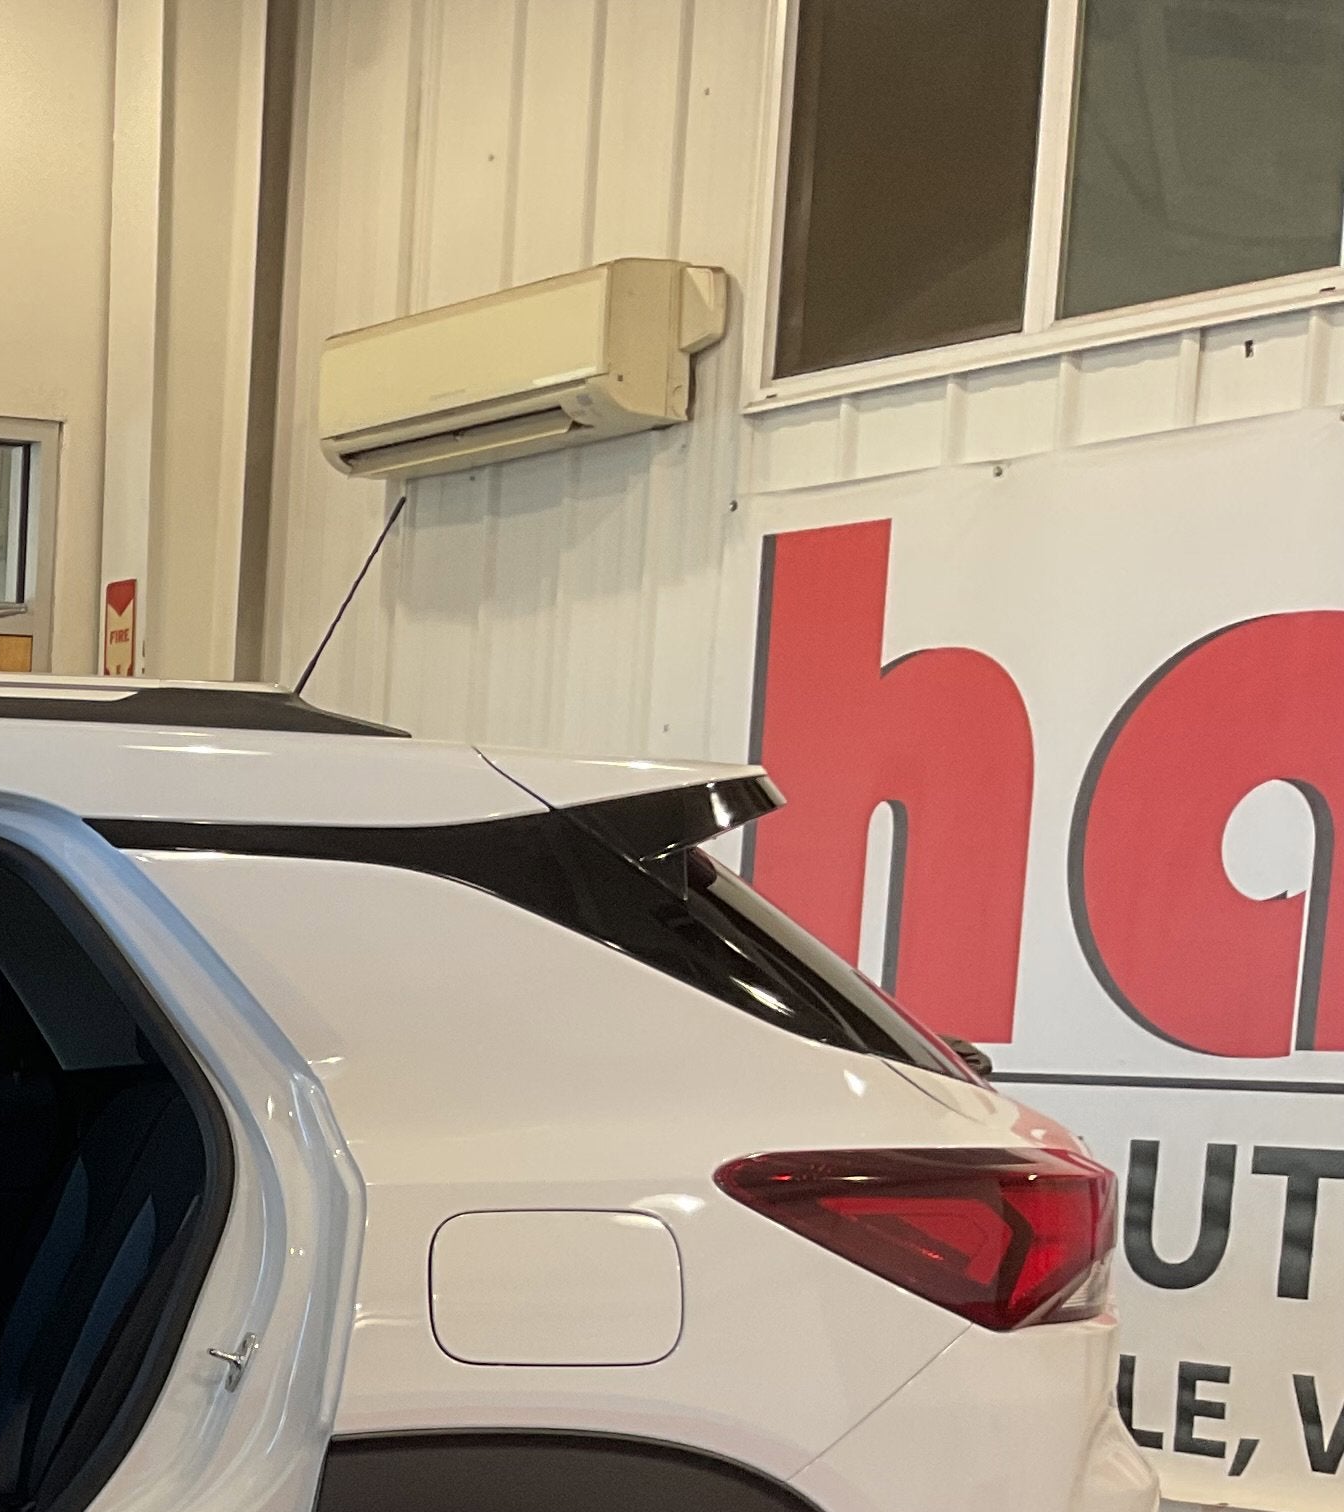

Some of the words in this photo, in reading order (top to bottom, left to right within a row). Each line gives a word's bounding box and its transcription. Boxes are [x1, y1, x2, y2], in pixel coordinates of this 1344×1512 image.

[109, 628, 130, 645] FIRE
[1123, 1138, 1344, 1300] UT
[1116, 1354, 1260, 1477] LE,
